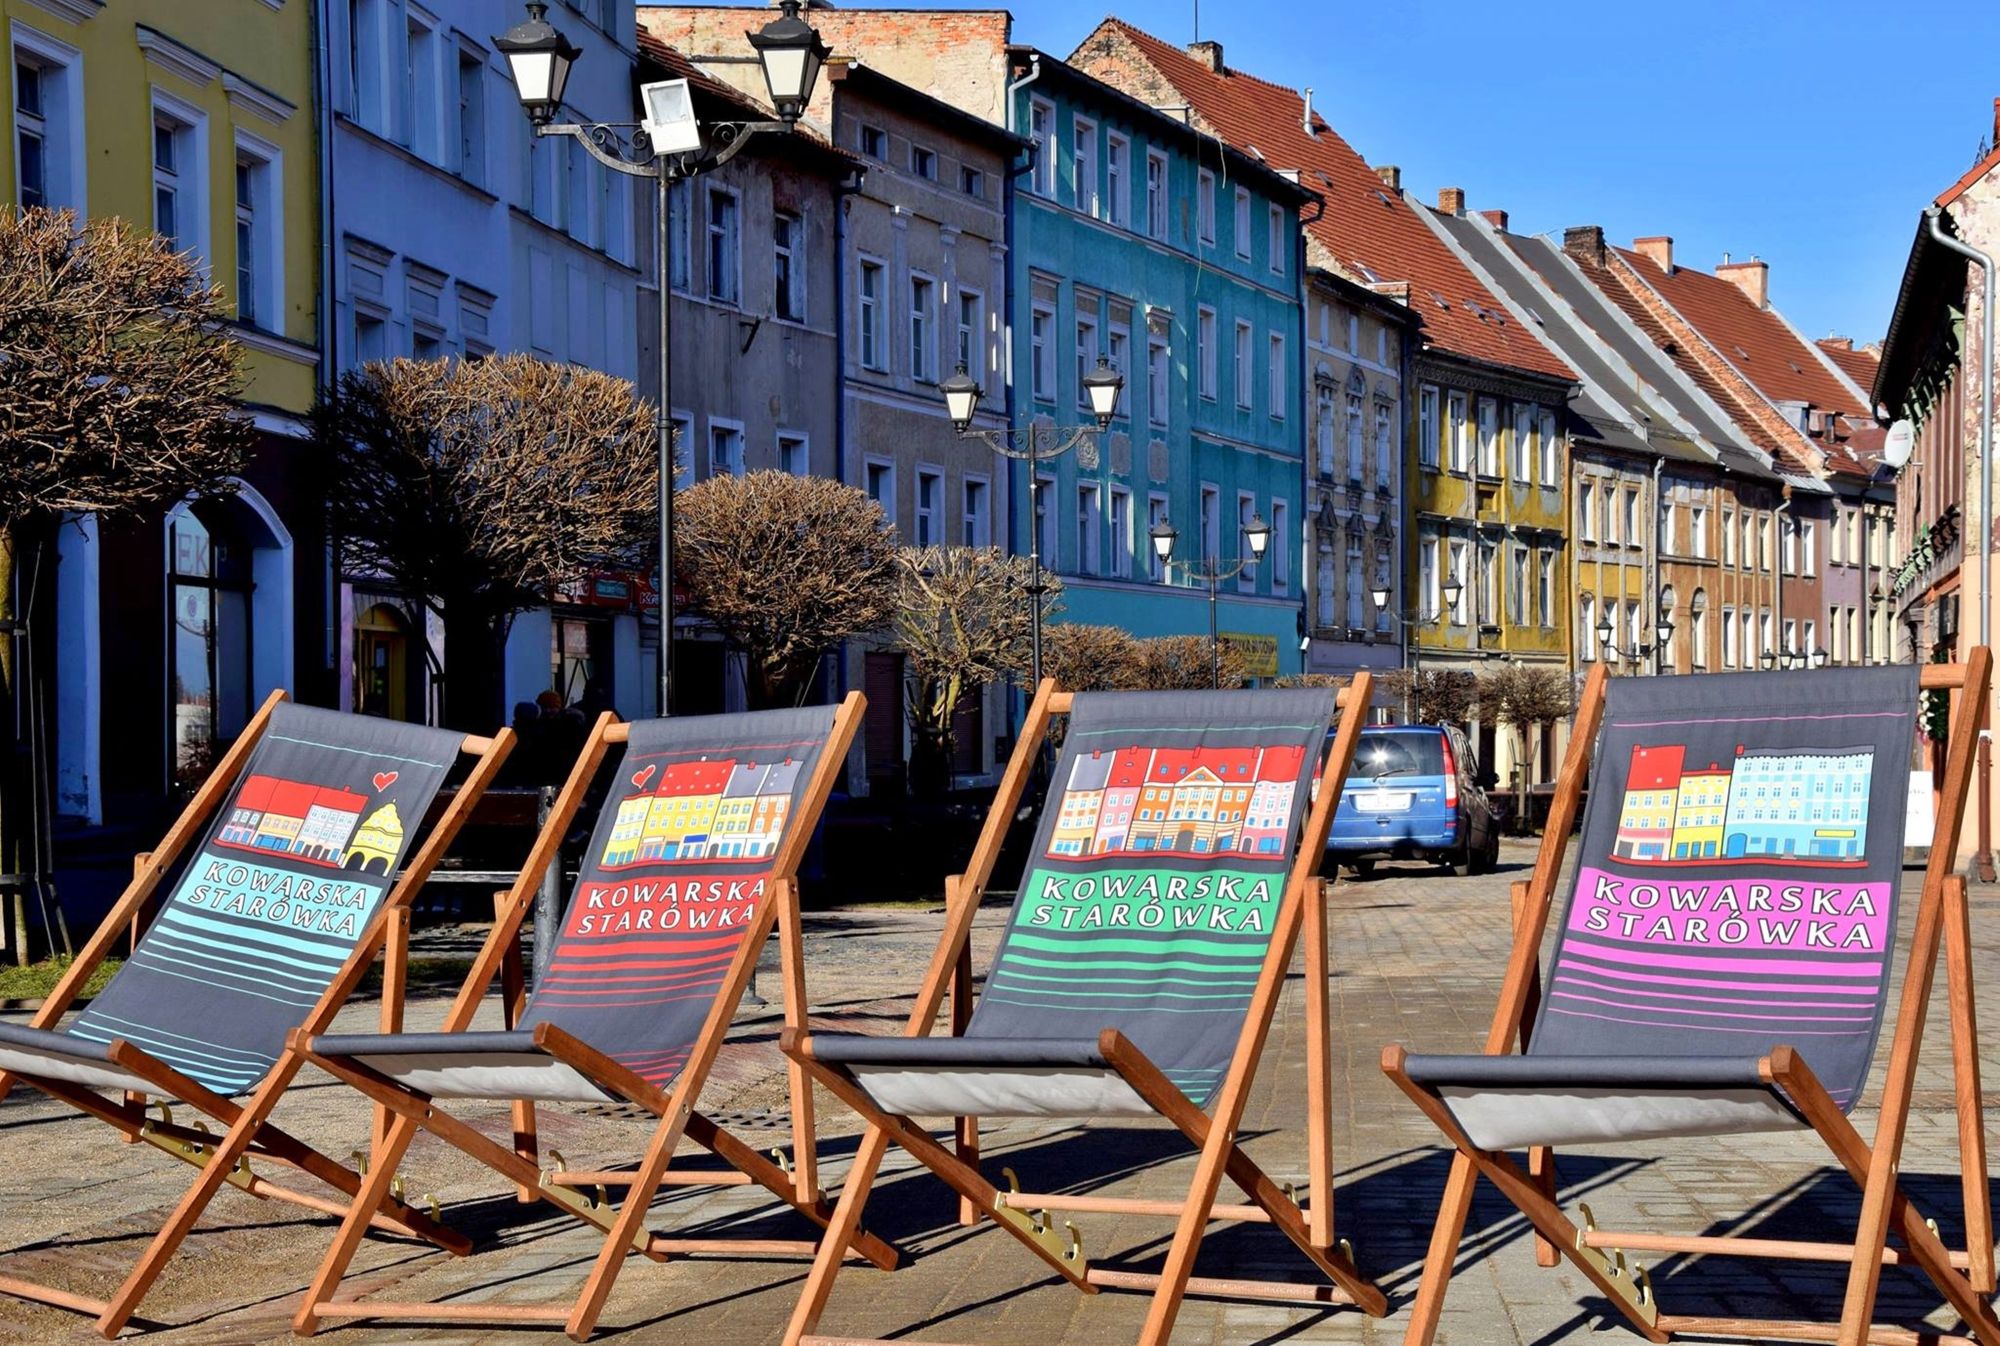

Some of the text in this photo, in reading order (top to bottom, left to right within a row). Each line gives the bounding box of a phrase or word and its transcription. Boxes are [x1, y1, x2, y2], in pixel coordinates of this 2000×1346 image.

[203, 861, 368, 910] KOWARSKA
[587, 878, 766, 909] KOWARSKA
[1041, 875, 1270, 903] KOWARSKA
[1594, 875, 1876, 917] KOWARSKA
[188, 885, 355, 936] STARÓWKA
[577, 902, 755, 934] STARÓWKA
[1030, 898, 1264, 931] STARÓWKA
[1585, 905, 1873, 949] STARÓWKA
